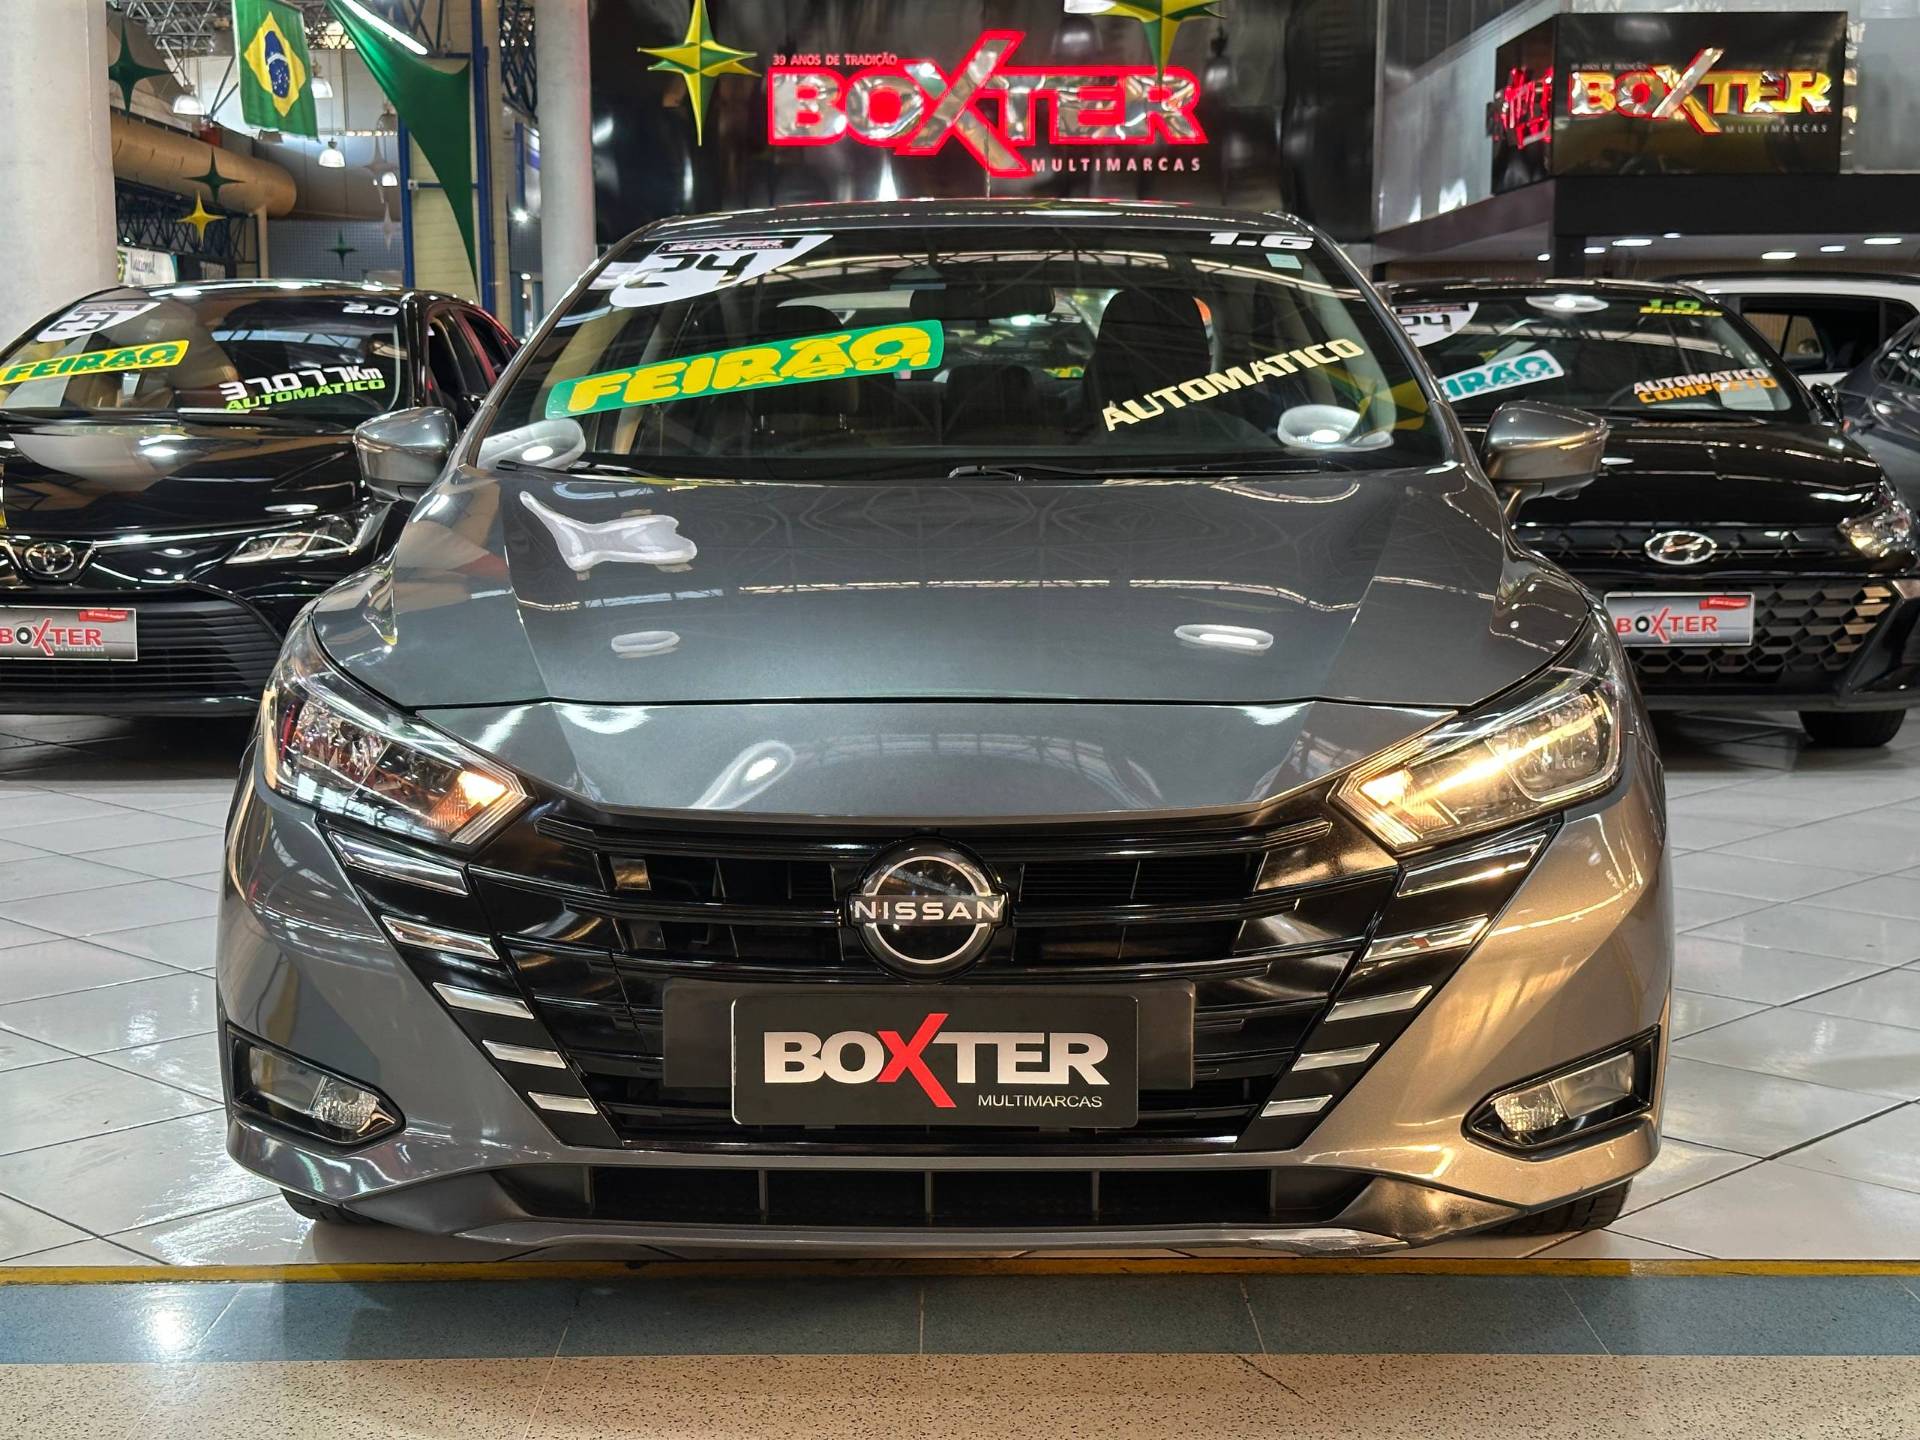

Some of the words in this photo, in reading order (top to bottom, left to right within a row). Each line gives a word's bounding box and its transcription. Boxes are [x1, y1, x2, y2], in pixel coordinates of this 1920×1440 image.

[773, 54, 786, 66] 39
[790, 54, 821, 66] ANOS
[825, 54, 840, 66] DE
[845, 52, 898, 67] TRADIÇÃO
[768, 30, 1208, 178] BOXTER
[1568, 47, 1833, 135] BOXTER
[1725, 124, 1828, 134] MULTIMARCAS
[1031, 157, 1200, 172] MULTIMARCAS
[1209, 232, 1315, 250] 1.6
[48, 311, 119, 332] 23
[343, 301, 400, 316] 2.0
[3, 344, 179, 382] FEIRÃO
[567, 327, 932, 412] FEIRÃO
[1442, 356, 1550, 397] IRÃO
[0, 618, 104, 656] BOXTER
[1616, 607, 1719, 643] BOXTER
[854, 900, 999, 920] NISSAN
[763, 1013, 1110, 1109] BOXTER
[978, 1094, 1103, 1108] MULTIMARCAS
